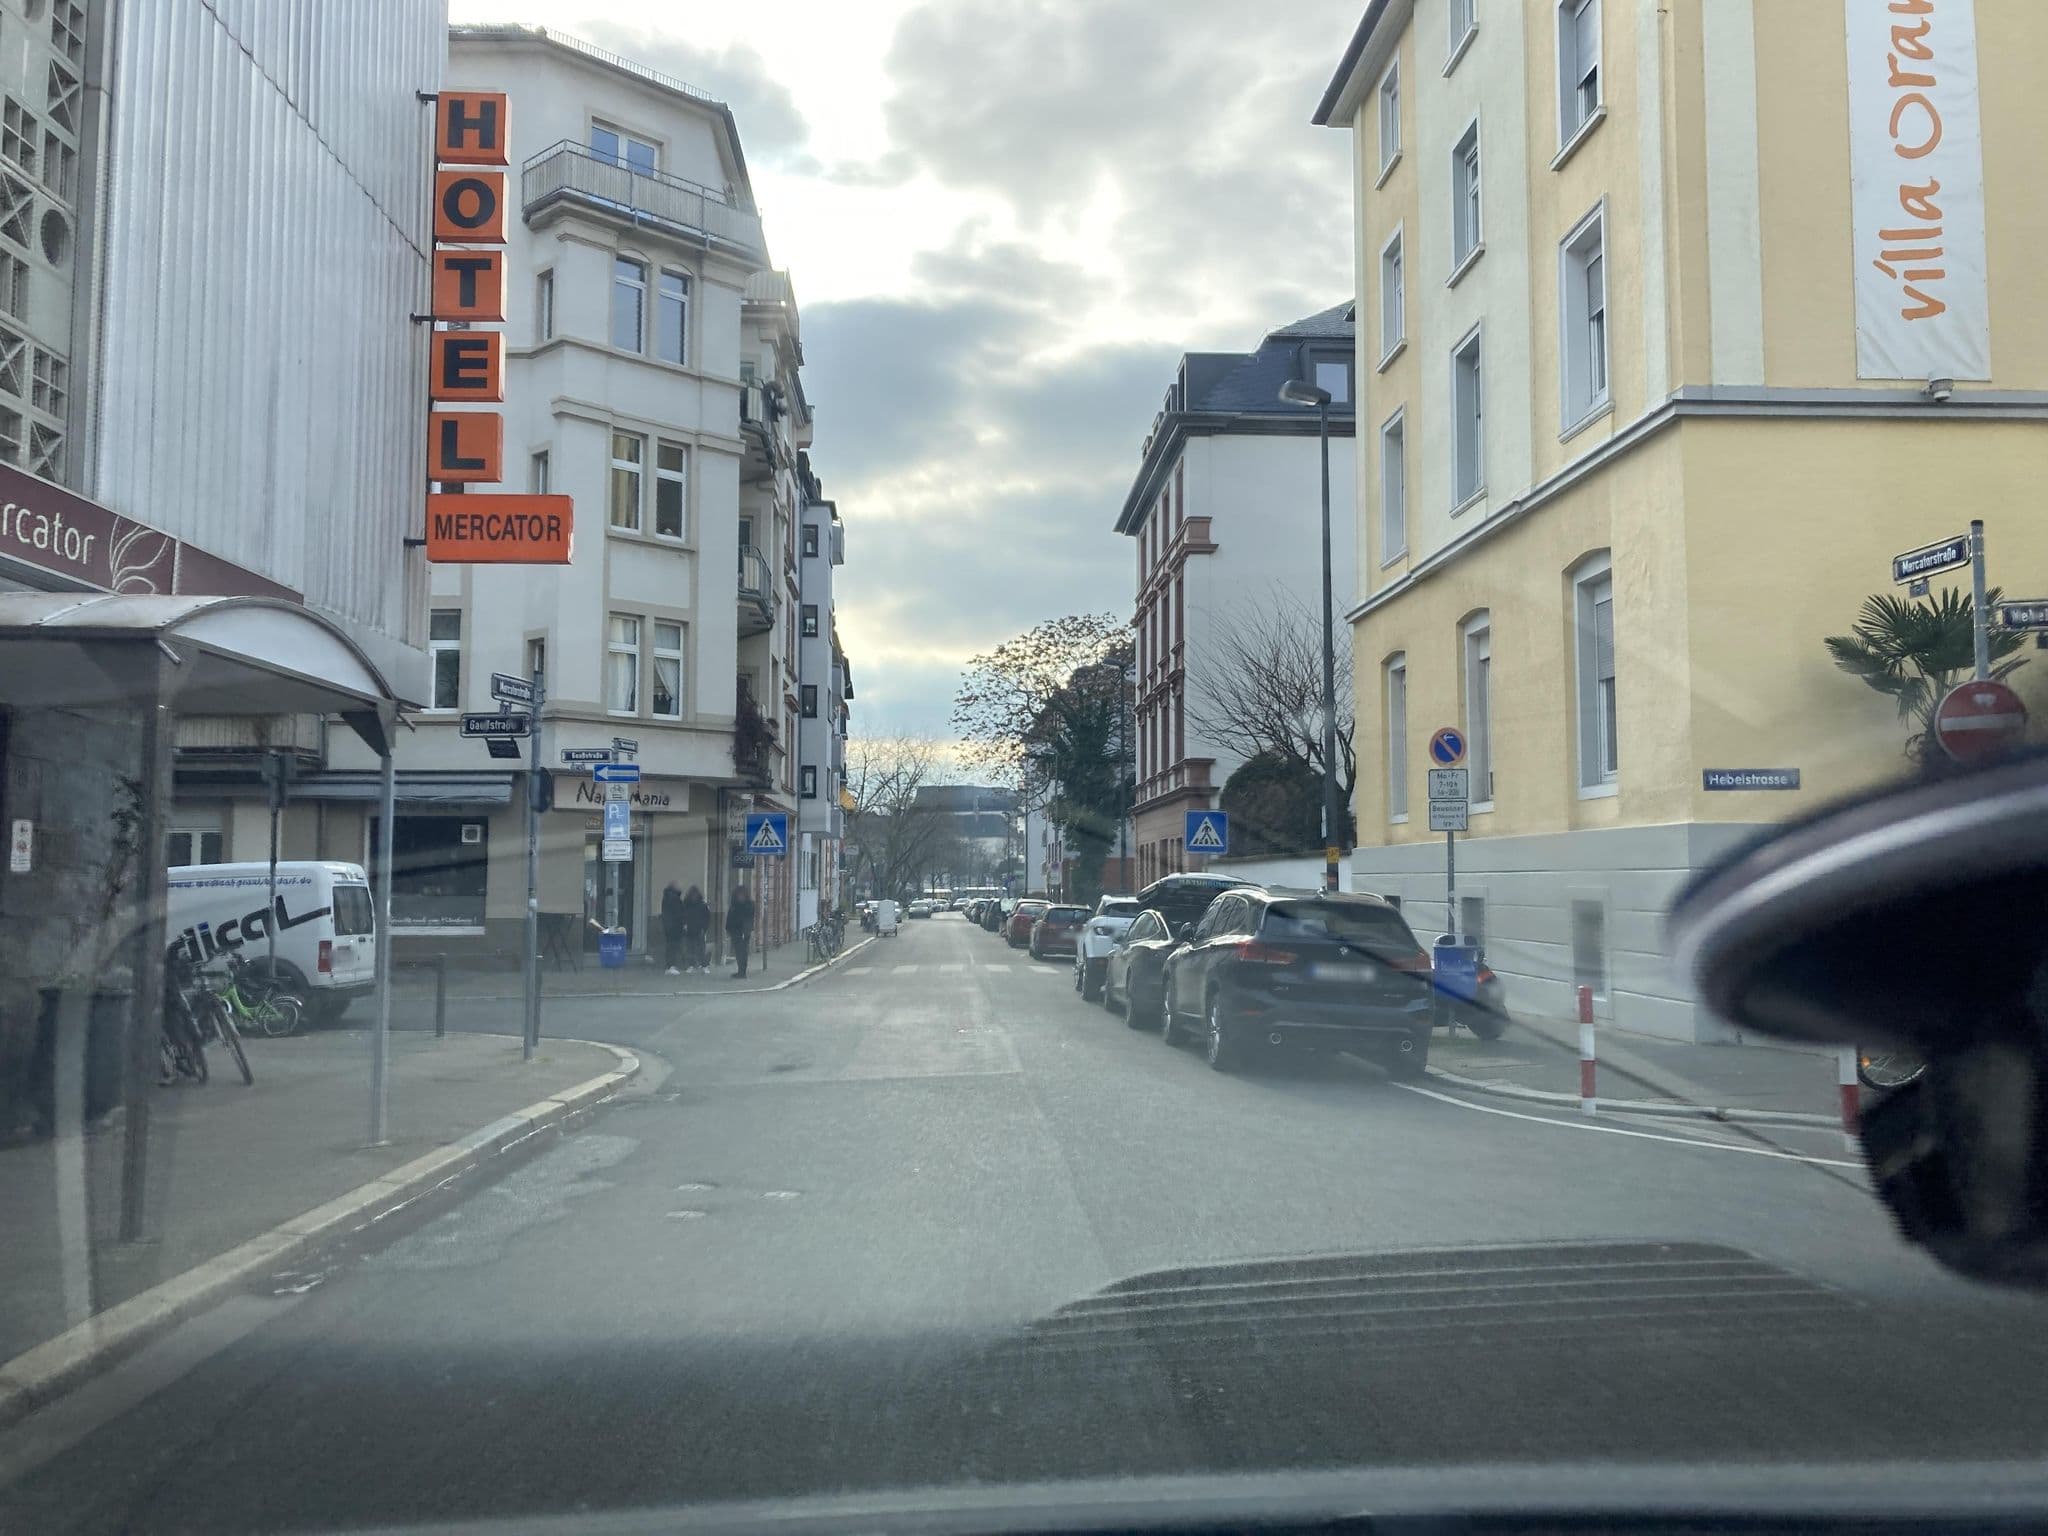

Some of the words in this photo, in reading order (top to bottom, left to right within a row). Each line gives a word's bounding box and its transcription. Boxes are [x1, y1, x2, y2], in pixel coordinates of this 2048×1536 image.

[441, 98, 497, 471] HOTEL
[1872, 176, 1946, 321] villa
[434, 513, 562, 543] MERCATOR
[1709, 773, 1788, 785] Hebelstrasse
